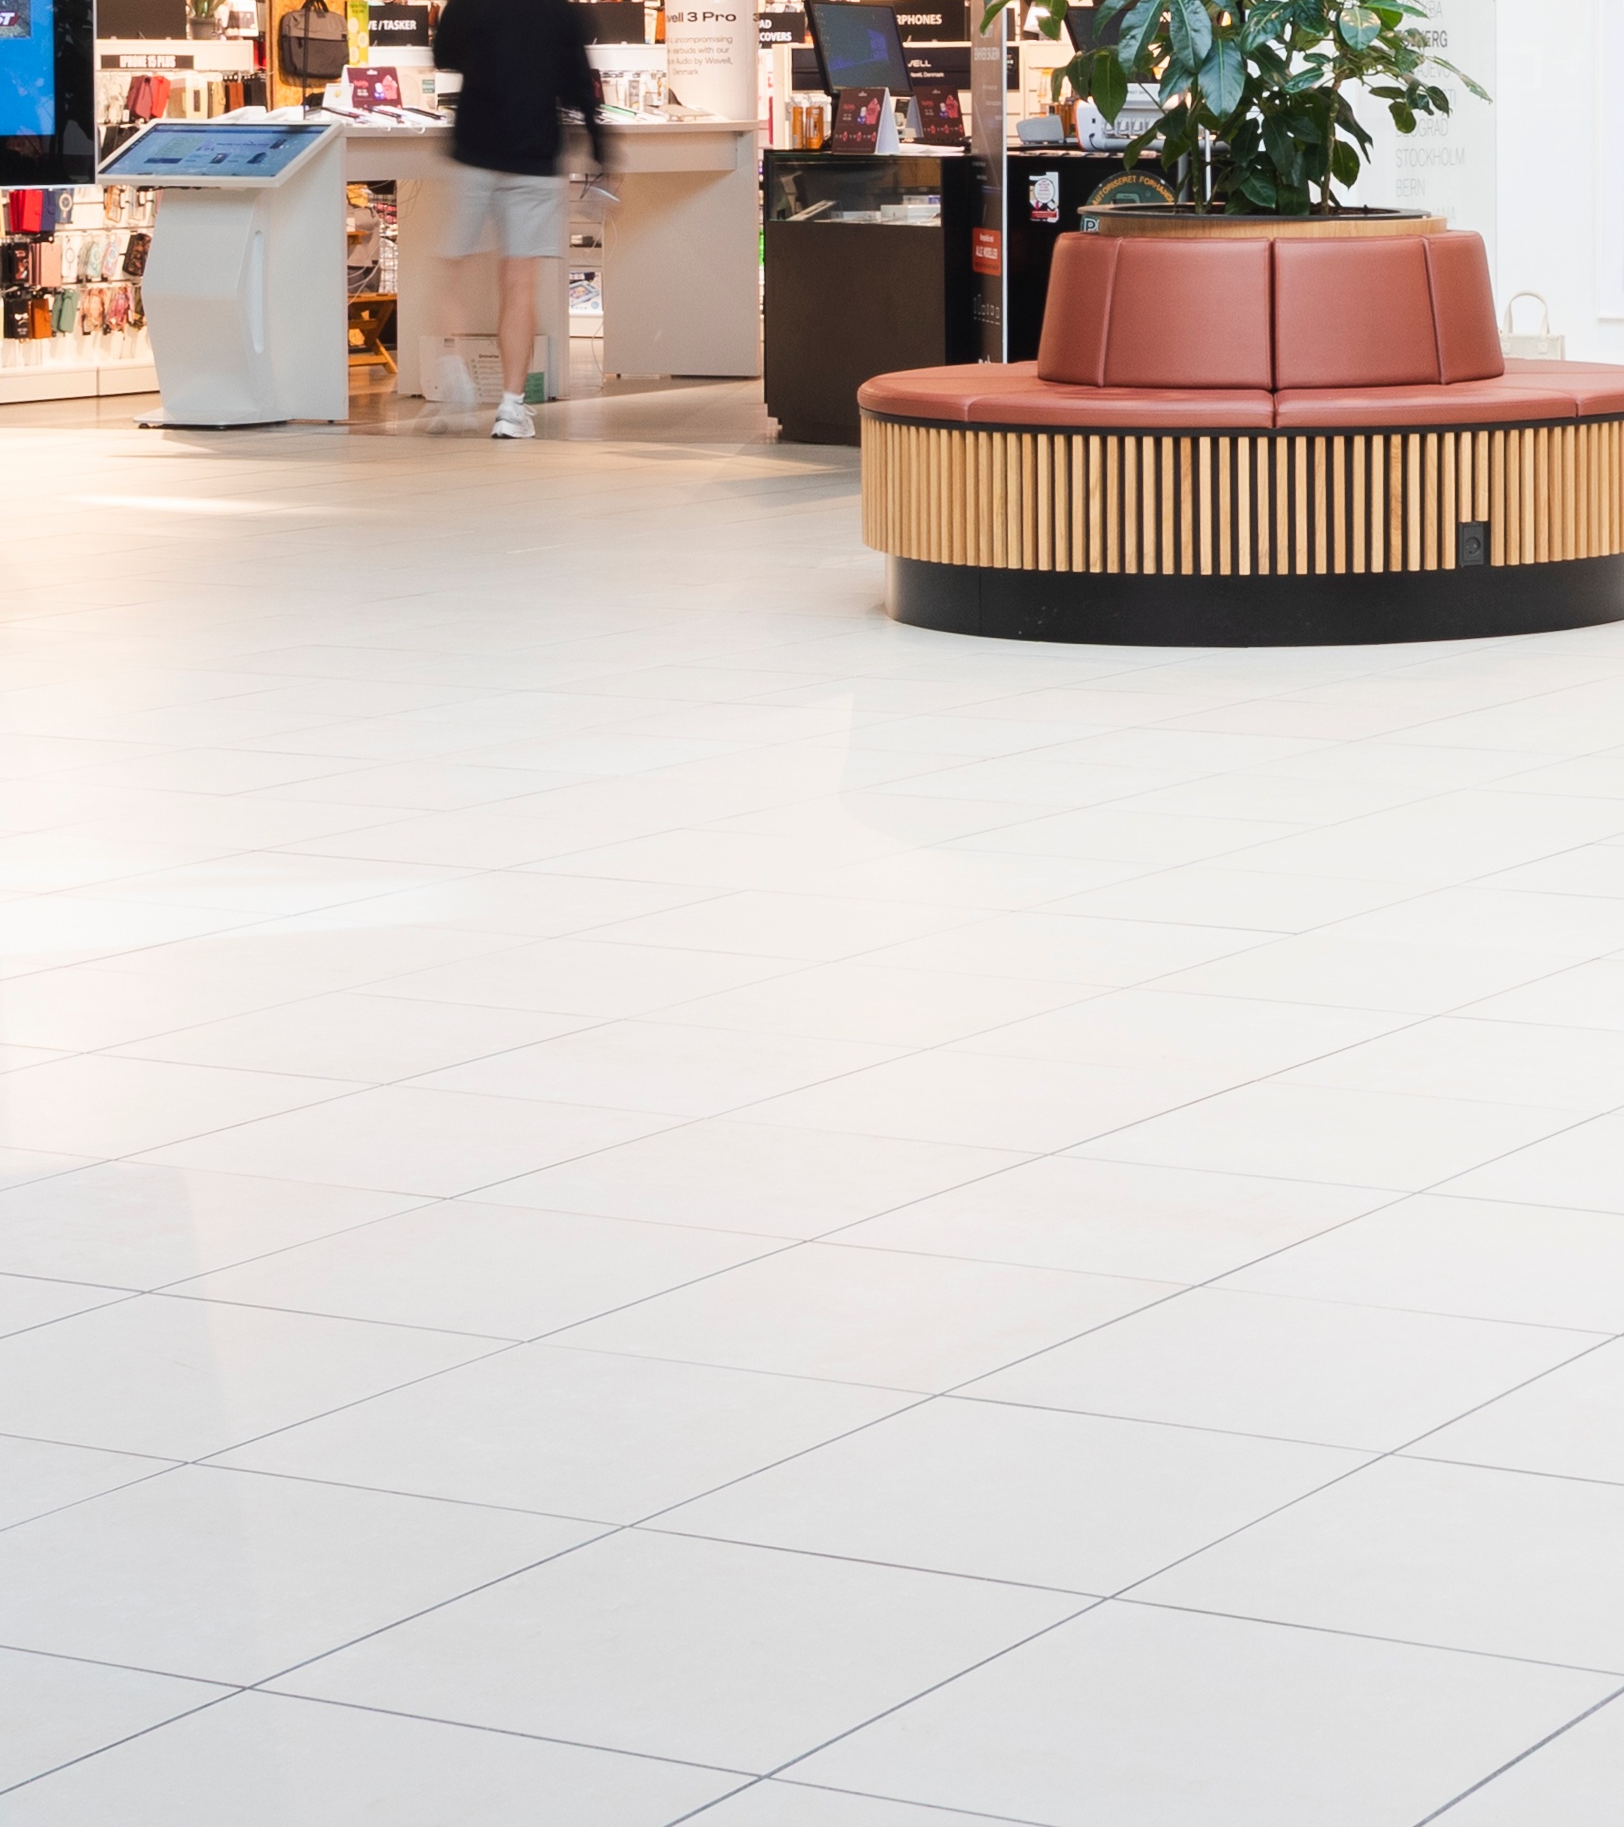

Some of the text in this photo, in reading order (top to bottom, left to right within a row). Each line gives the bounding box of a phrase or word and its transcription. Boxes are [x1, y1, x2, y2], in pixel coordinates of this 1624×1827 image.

[687, 12, 737, 22] 3 Pro
[760, 32, 792, 42] COVERS
[698, 46, 714, 54] with
[693, 57, 702, 66] by
[1395, 147, 1465, 168] STOCKHOLM
[1395, 178, 1426, 198] BERN
